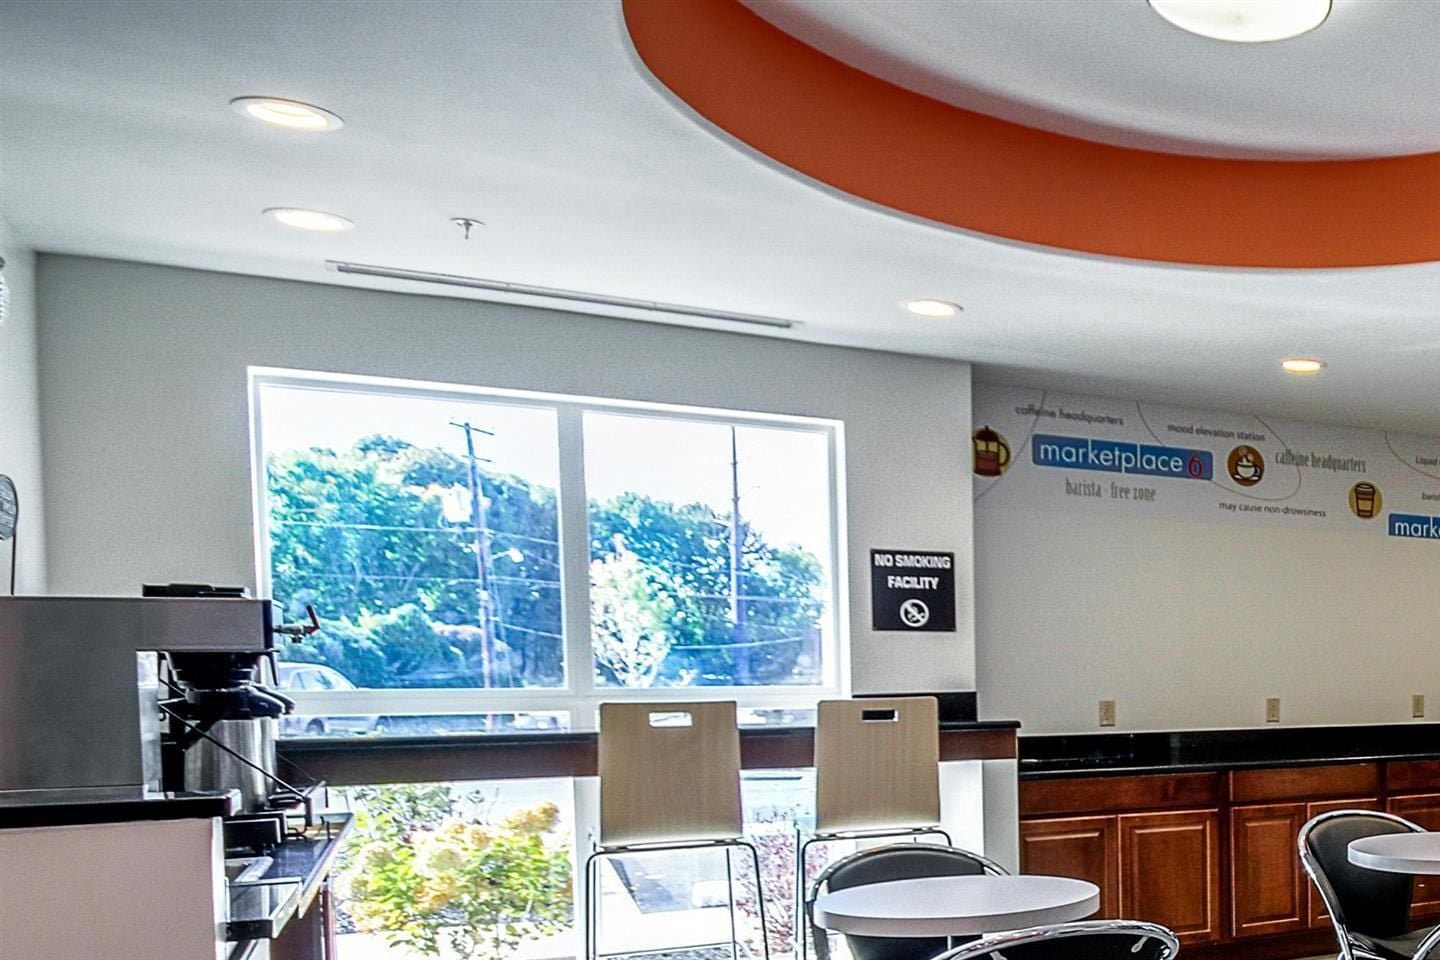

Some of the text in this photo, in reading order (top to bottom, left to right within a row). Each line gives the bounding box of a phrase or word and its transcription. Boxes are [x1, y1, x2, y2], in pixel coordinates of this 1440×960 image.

[1059, 408, 1125, 426] headquarters
[1167, 424, 1266, 442] mood elevation station
[1040, 438, 1184, 474] marketplace
[1311, 451, 1367, 474] headquarters
[1218, 502, 1237, 513] may
[1239, 503, 1262, 513] cause
[874, 553, 952, 569] NO SMOKING
[887, 575, 940, 590] FACILITY
